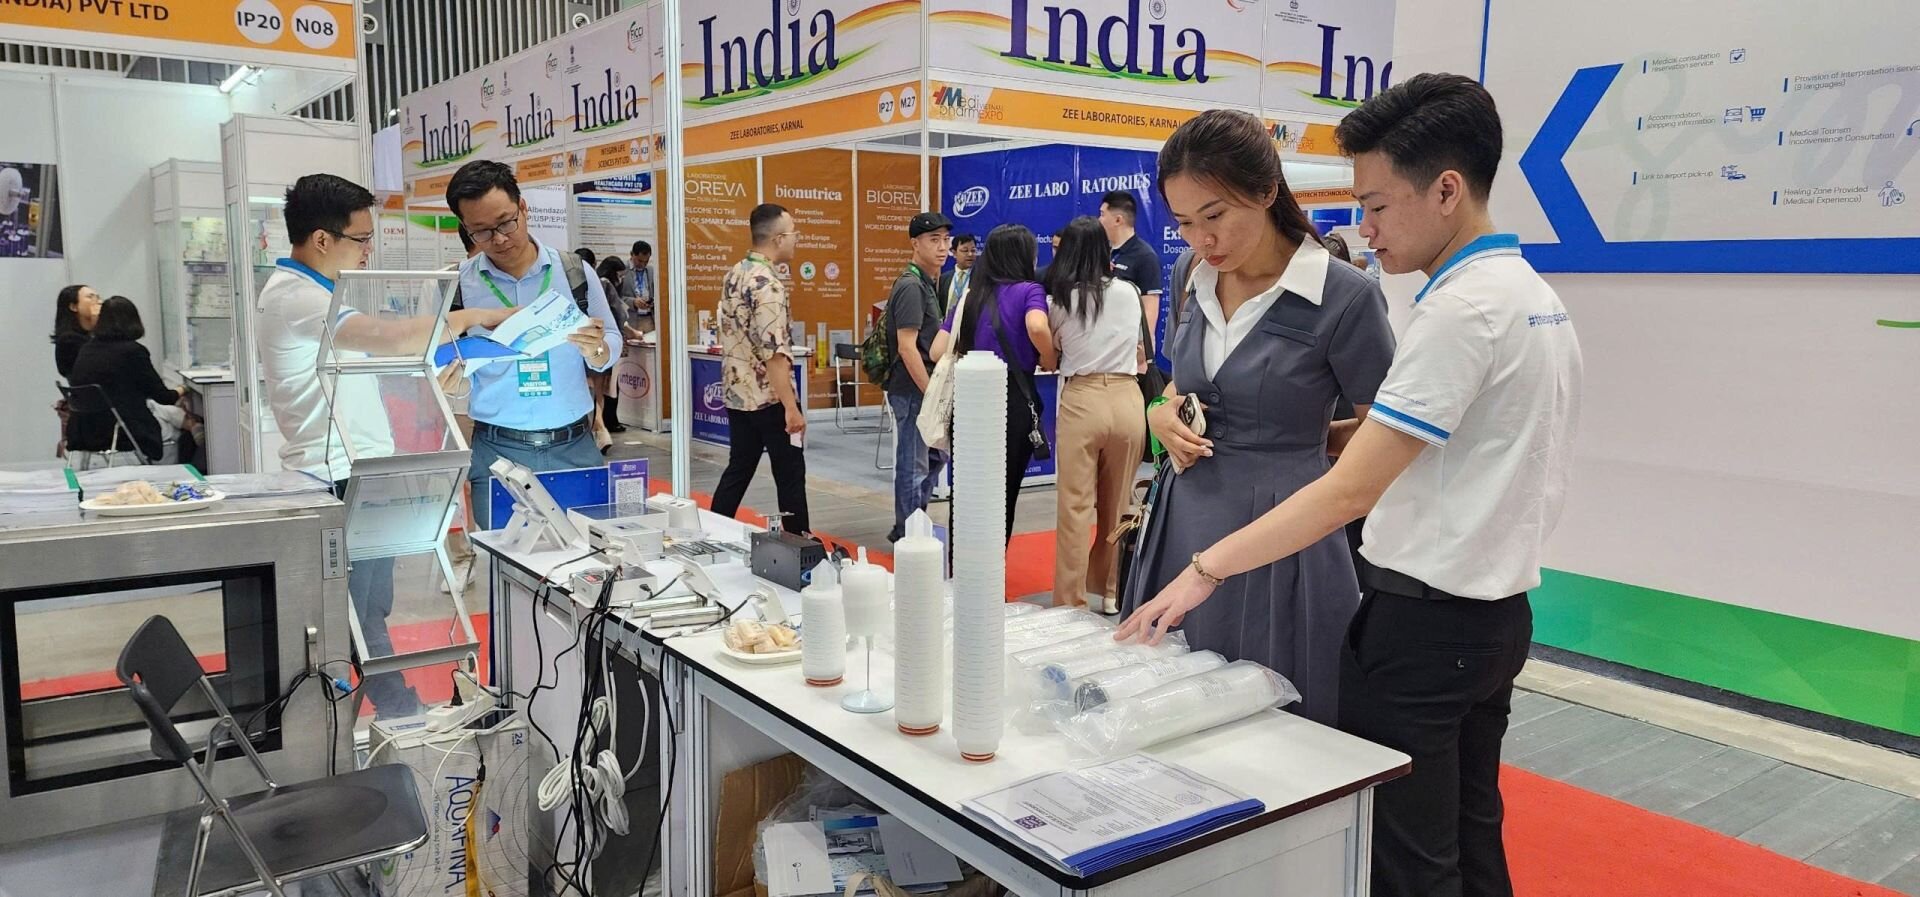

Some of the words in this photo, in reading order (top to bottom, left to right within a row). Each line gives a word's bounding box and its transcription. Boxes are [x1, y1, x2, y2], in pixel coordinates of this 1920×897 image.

[80, 0, 122, 16] PVT
[130, 3, 169, 21] LTD
[238, 11, 281, 30] IP20
[296, 18, 334, 36] N08
[1000, 0, 1210, 84] India
[699, 0, 840, 101] India
[1651, 62, 1688, 72] reservation
[1689, 60, 1714, 68] service
[1652, 57, 1677, 66] Medical
[1679, 52, 1720, 63] consultation
[1794, 74, 1829, 83] Provision
[1831, 71, 1839, 79] of
[1841, 67, 1895, 79] interpretation
[1804, 79, 1846, 91] languages)
[571, 68, 639, 133] India
[878, 101, 894, 114] IP27
[900, 96, 916, 109] M27
[940, 105, 979, 119] pharm
[979, 110, 1004, 121] EXPO
[1062, 108, 1079, 120] ZEE
[1081, 110, 1148, 128] LABORATORIES,
[505, 92, 554, 148] India
[1646, 120, 1676, 130] shopping
[1677, 117, 1717, 127] information
[420, 101, 472, 163] India
[730, 131, 740, 141] ZEE
[740, 123, 781, 139] LABORATORIES,
[780, 119, 804, 132] KARNAL
[1789, 129, 1819, 137] Medical
[1821, 127, 1852, 136] Tourism
[1789, 135, 1843, 145] Inconvenience
[1845, 132, 1895, 142] Consultation
[1665, 172, 1687, 181] airport
[685, 179, 747, 197] OREVA
[775, 184, 843, 201] bionutrica
[1009, 184, 1033, 200] ZEE
[1293, 191, 1318, 199] EDITECH
[1784, 187, 1812, 198] Healing
[1813, 187, 1832, 195] Zone
[1834, 185, 1869, 194] Provided
[866, 189, 921, 206] BIOREV
[966, 190, 984, 204] ZEE
[1783, 196, 1814, 206] (Medical
[1816, 195, 1862, 205] Experience)
[715, 207, 723, 215] TO
[724, 208, 736, 216] THE
[795, 208, 824, 216] Preventive
[383, 227, 405, 235] OEM
[694, 411, 704, 421] ZEE
[704, 413, 729, 426] LABORAT
[515, 732, 522, 745] 24
